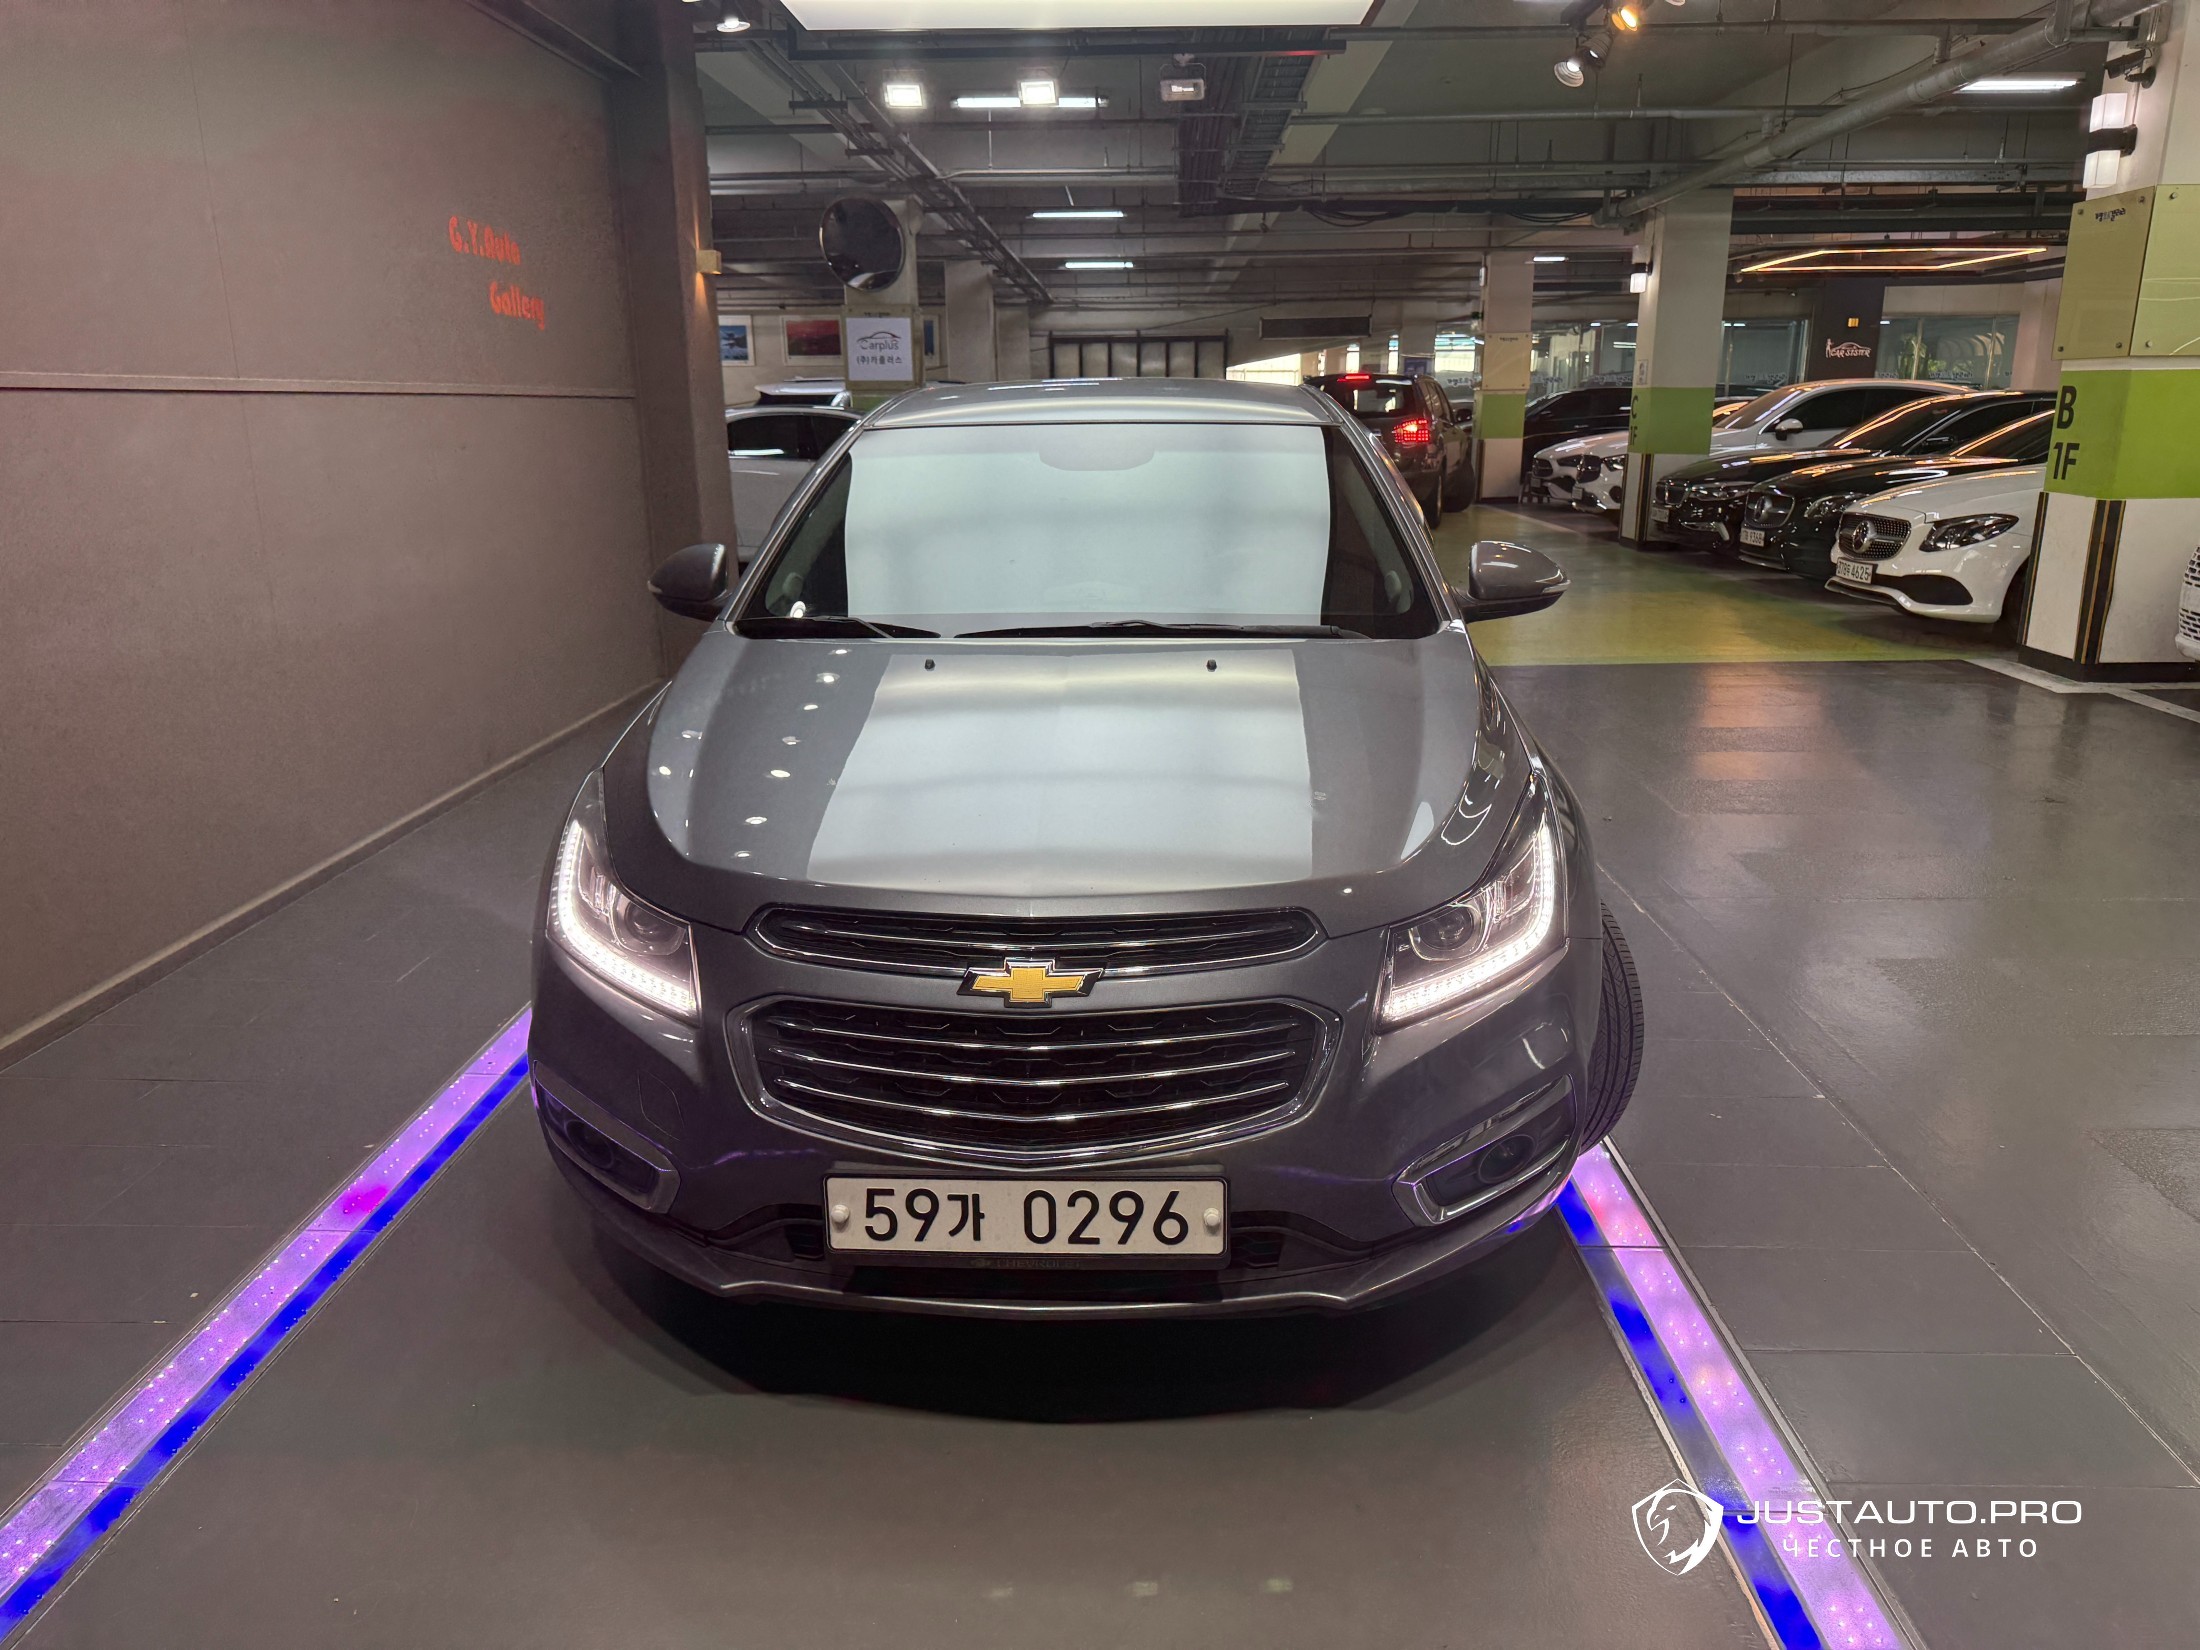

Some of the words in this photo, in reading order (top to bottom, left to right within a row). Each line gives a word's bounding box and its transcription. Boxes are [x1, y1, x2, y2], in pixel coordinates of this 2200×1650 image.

[489, 280, 545, 331] Gallery
[859, 339, 900, 352] Carplus
[1631, 394, 1639, 419] C
[2056, 385, 2077, 430] B
[2053, 442, 2080, 480] 1F
[864, 1188, 985, 1242] 59가
[1023, 1190, 1189, 1245] 0296
